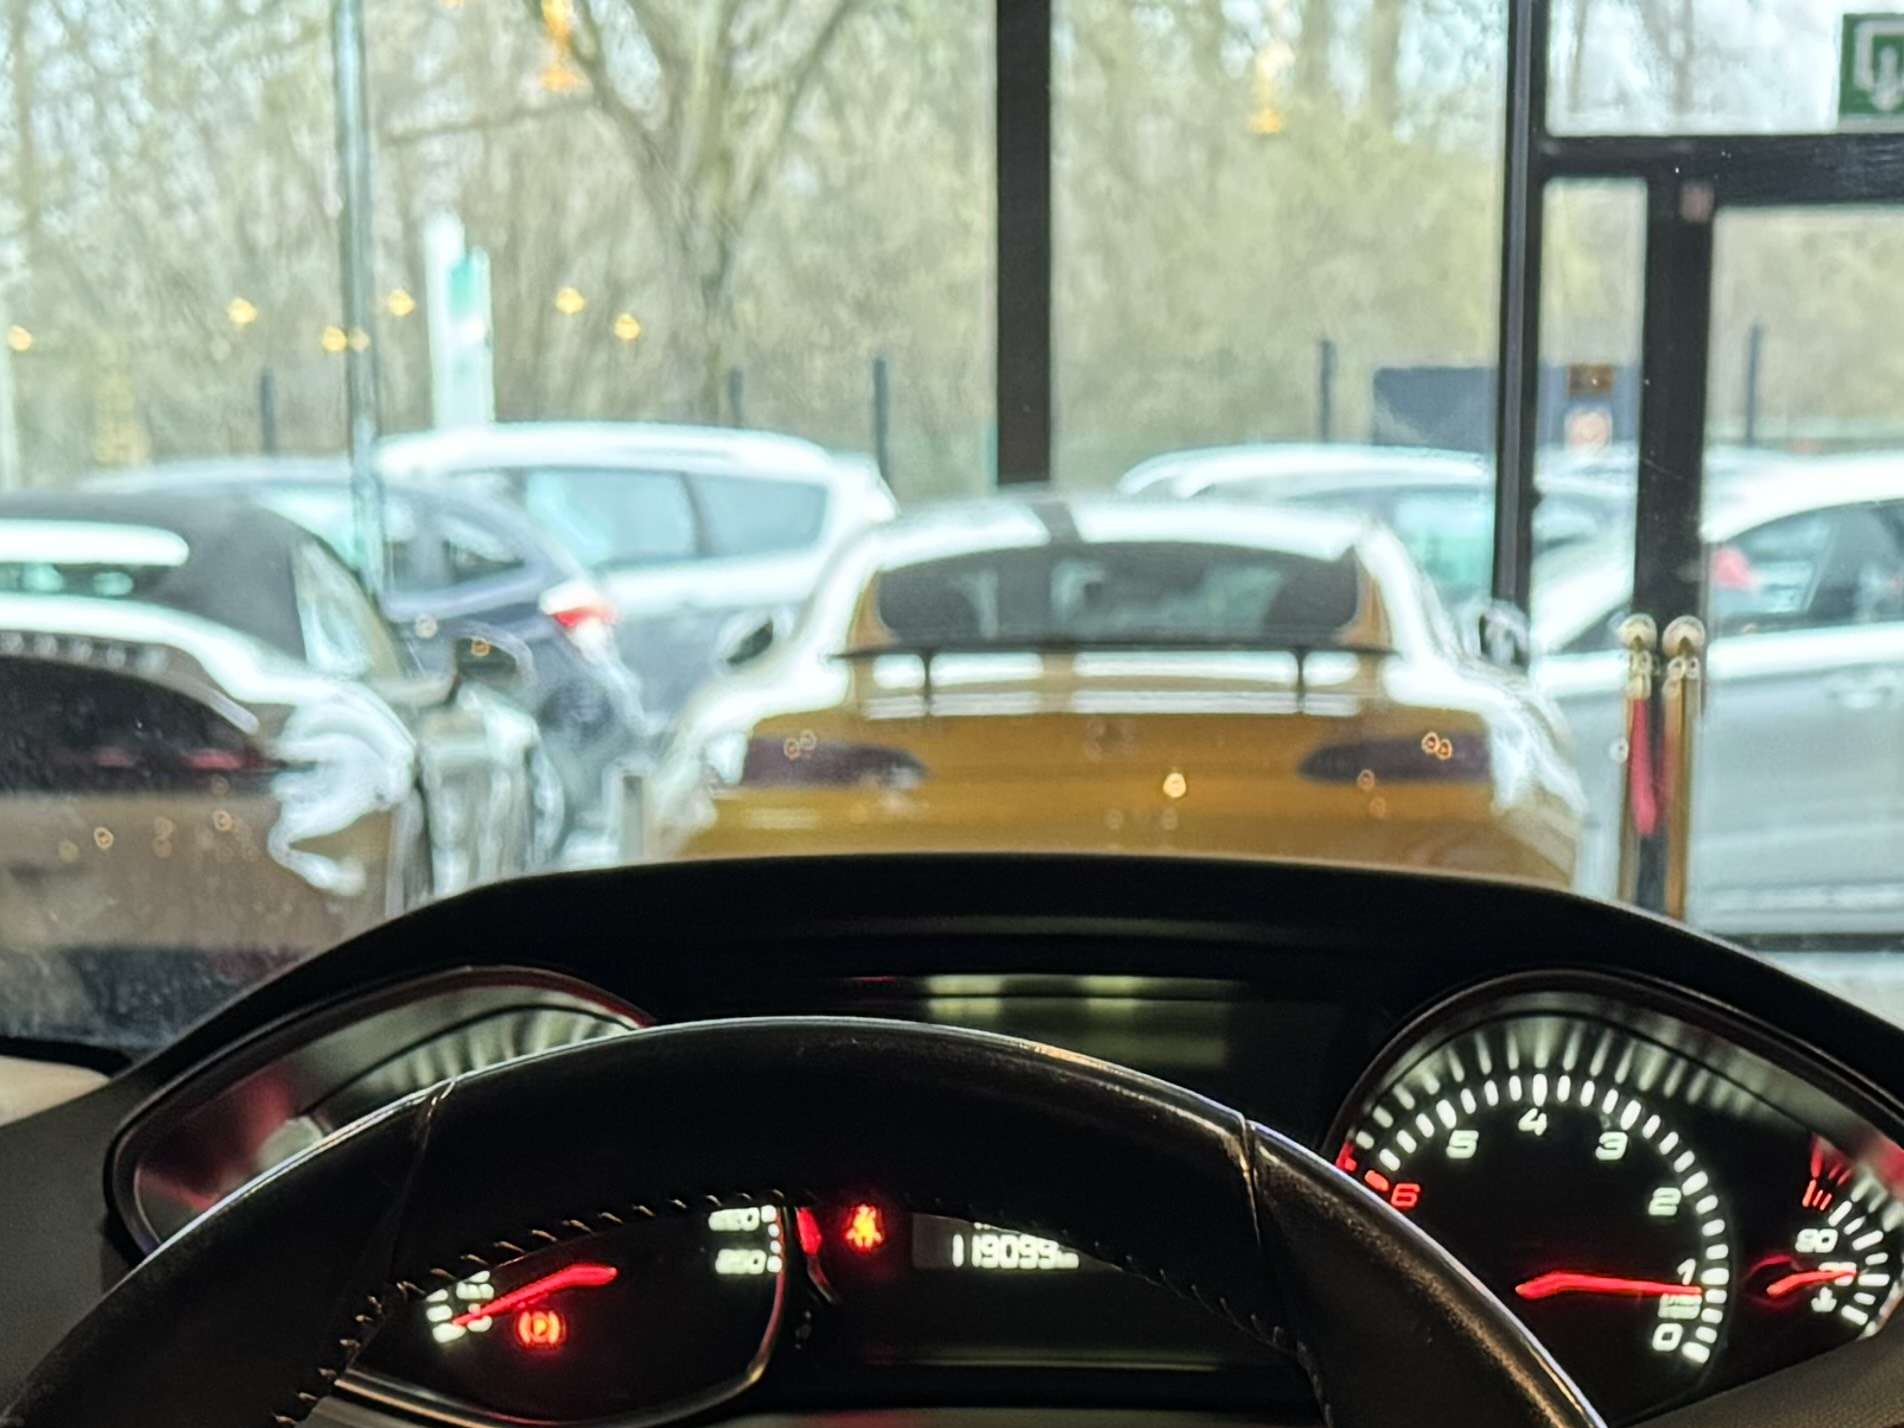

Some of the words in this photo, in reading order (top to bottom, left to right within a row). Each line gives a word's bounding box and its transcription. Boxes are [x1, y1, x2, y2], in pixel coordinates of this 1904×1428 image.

[1518, 1108, 1549, 1136] 4
[1447, 1130, 1479, 1159] 5
[1595, 1132, 1629, 1160] 3
[1390, 1183, 1422, 1208] 6
[1648, 1188, 1682, 1216] 2
[1676, 1258, 1696, 1285] 1
[1652, 1324, 1683, 1351] 0
